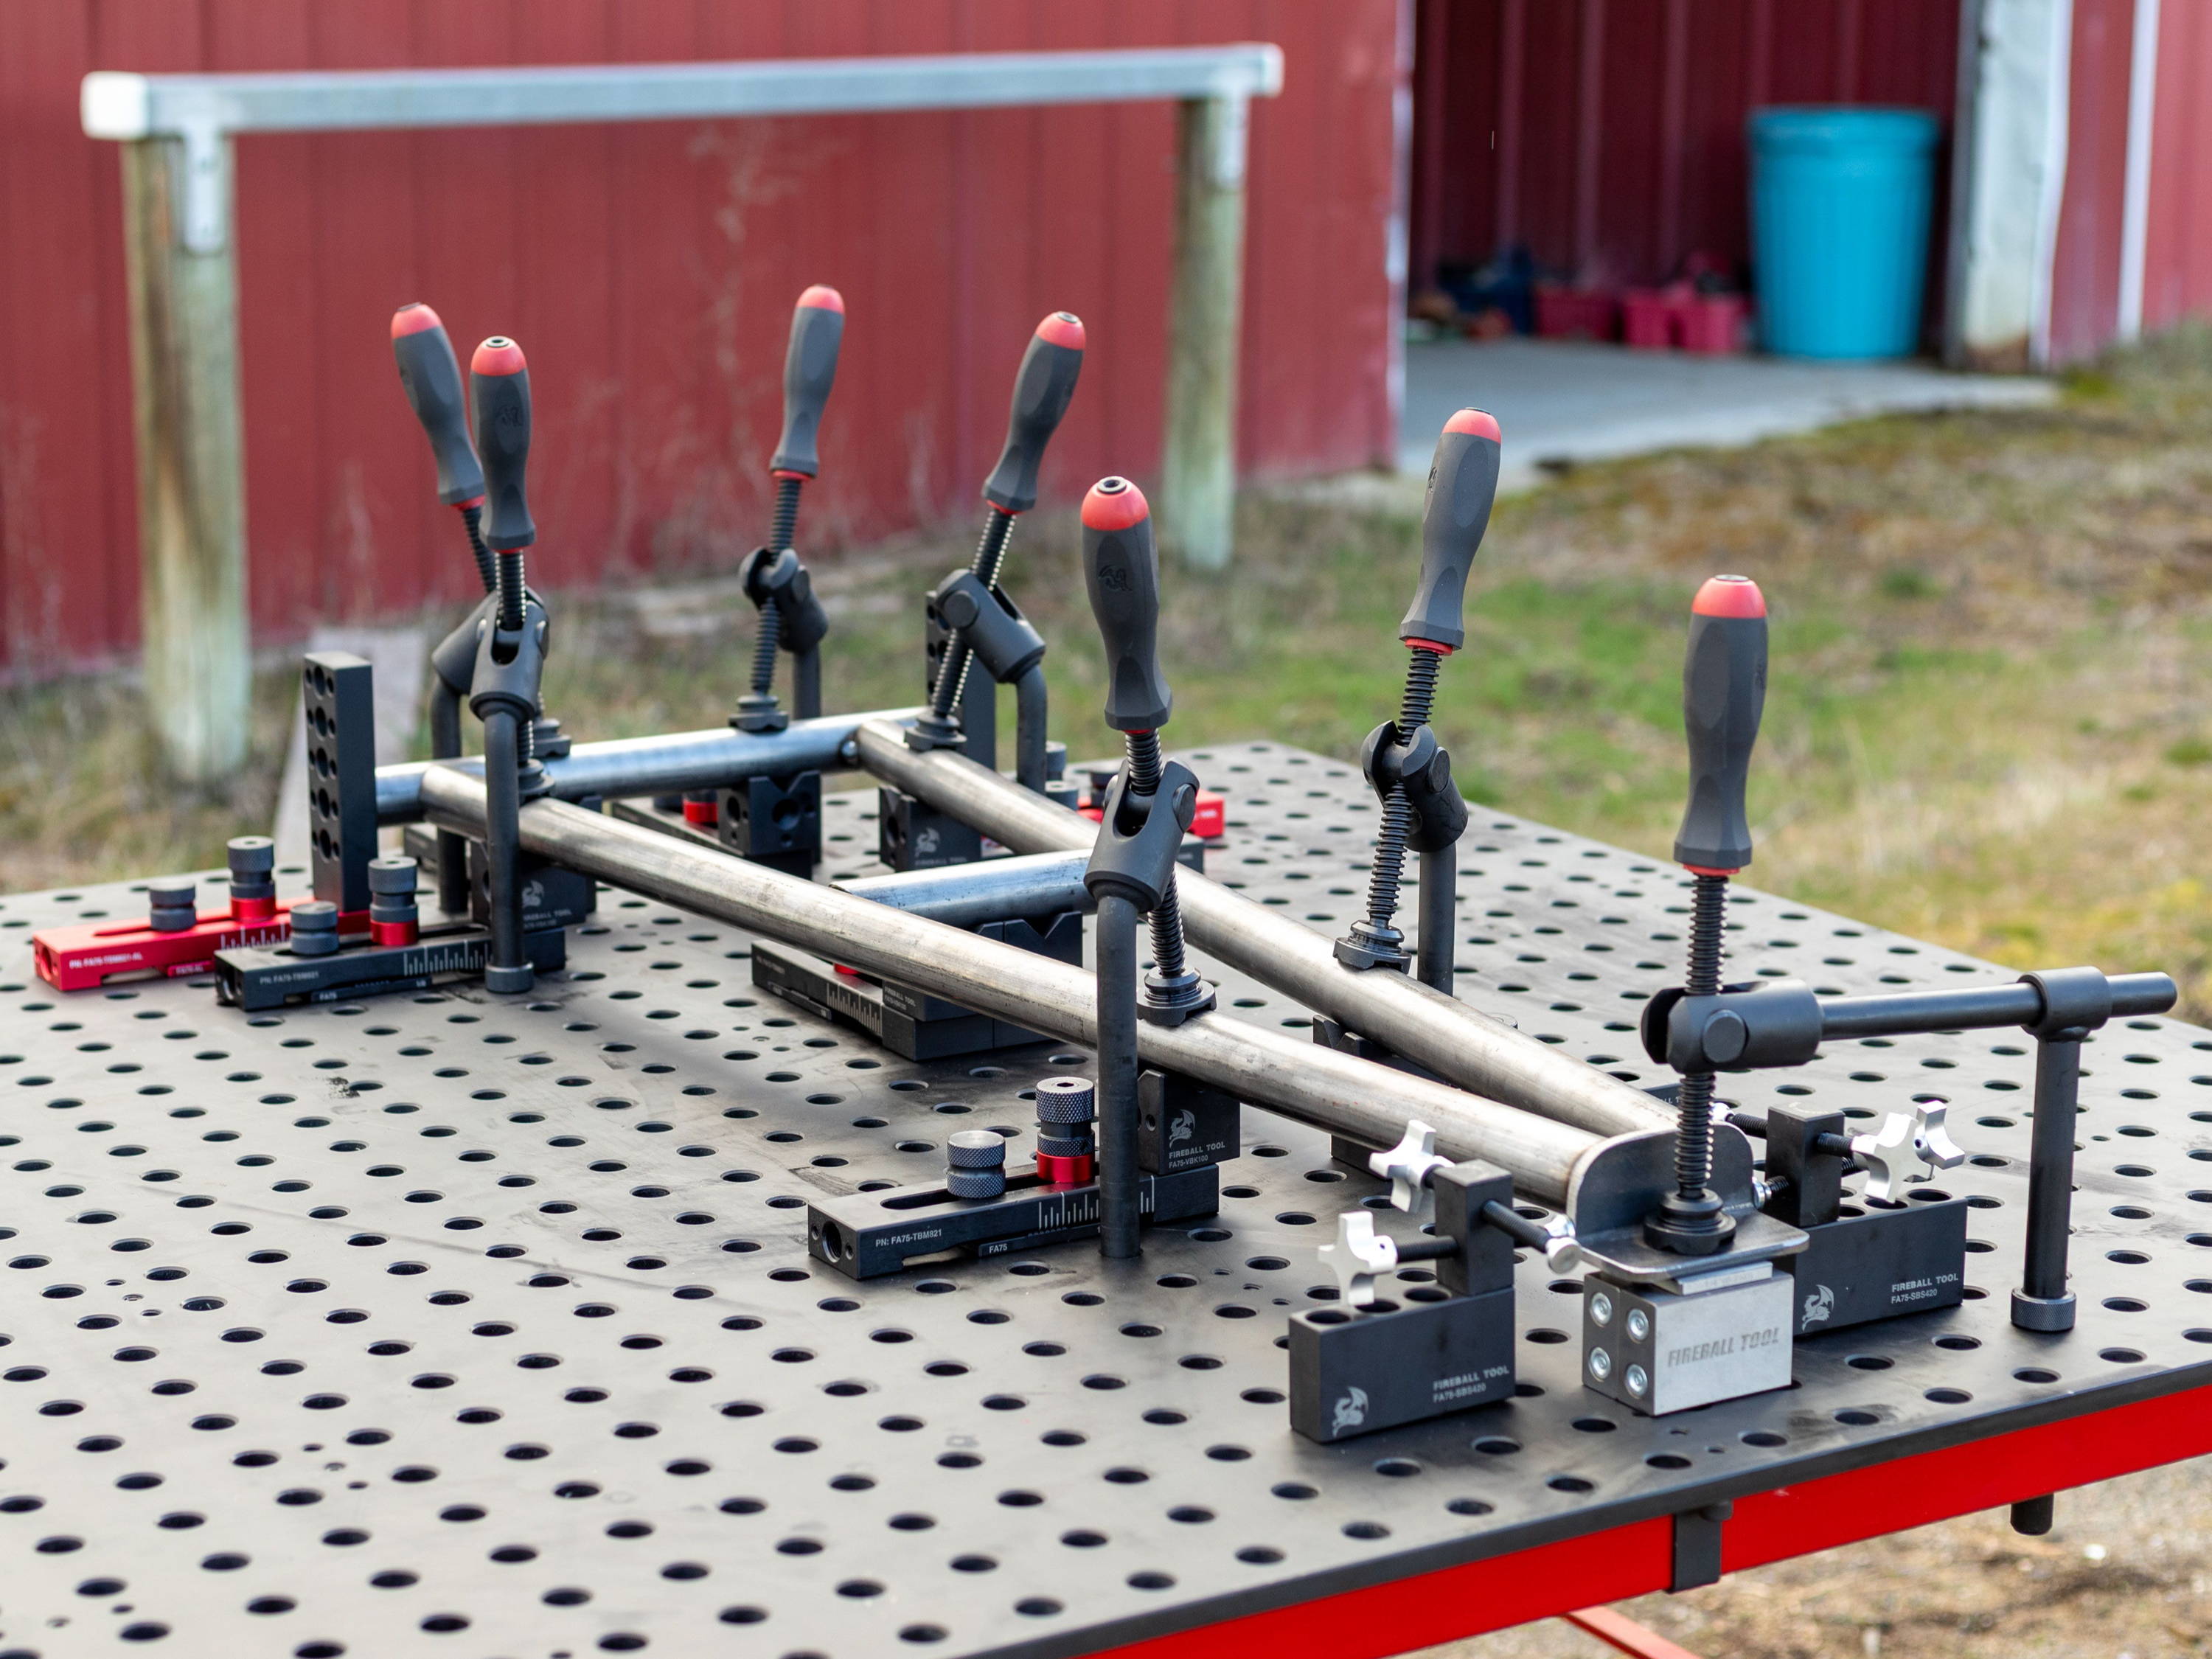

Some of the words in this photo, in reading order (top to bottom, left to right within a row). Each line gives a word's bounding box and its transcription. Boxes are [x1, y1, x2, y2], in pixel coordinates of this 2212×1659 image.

[1169, 1146, 1203, 1159] FIREBALL
[1206, 1141, 1225, 1151] TOOL
[1169, 1155, 1208, 1169] FA75-VBK100
[875, 1237, 890, 1247] PN:
[891, 1228, 942, 1245] FA75-TBM821
[989, 1243, 1008, 1253] FA75
[1891, 1278, 1933, 1293] FIREBALL
[1935, 1273, 1958, 1284] TOOL
[1891, 1288, 1938, 1304] FA75-SBS420
[1667, 1337, 1734, 1368] FIREBALL
[1740, 1327, 1780, 1352] TOOL
[1433, 1371, 1481, 1391] FIREBALL
[1483, 1365, 1509, 1380] TOOL
